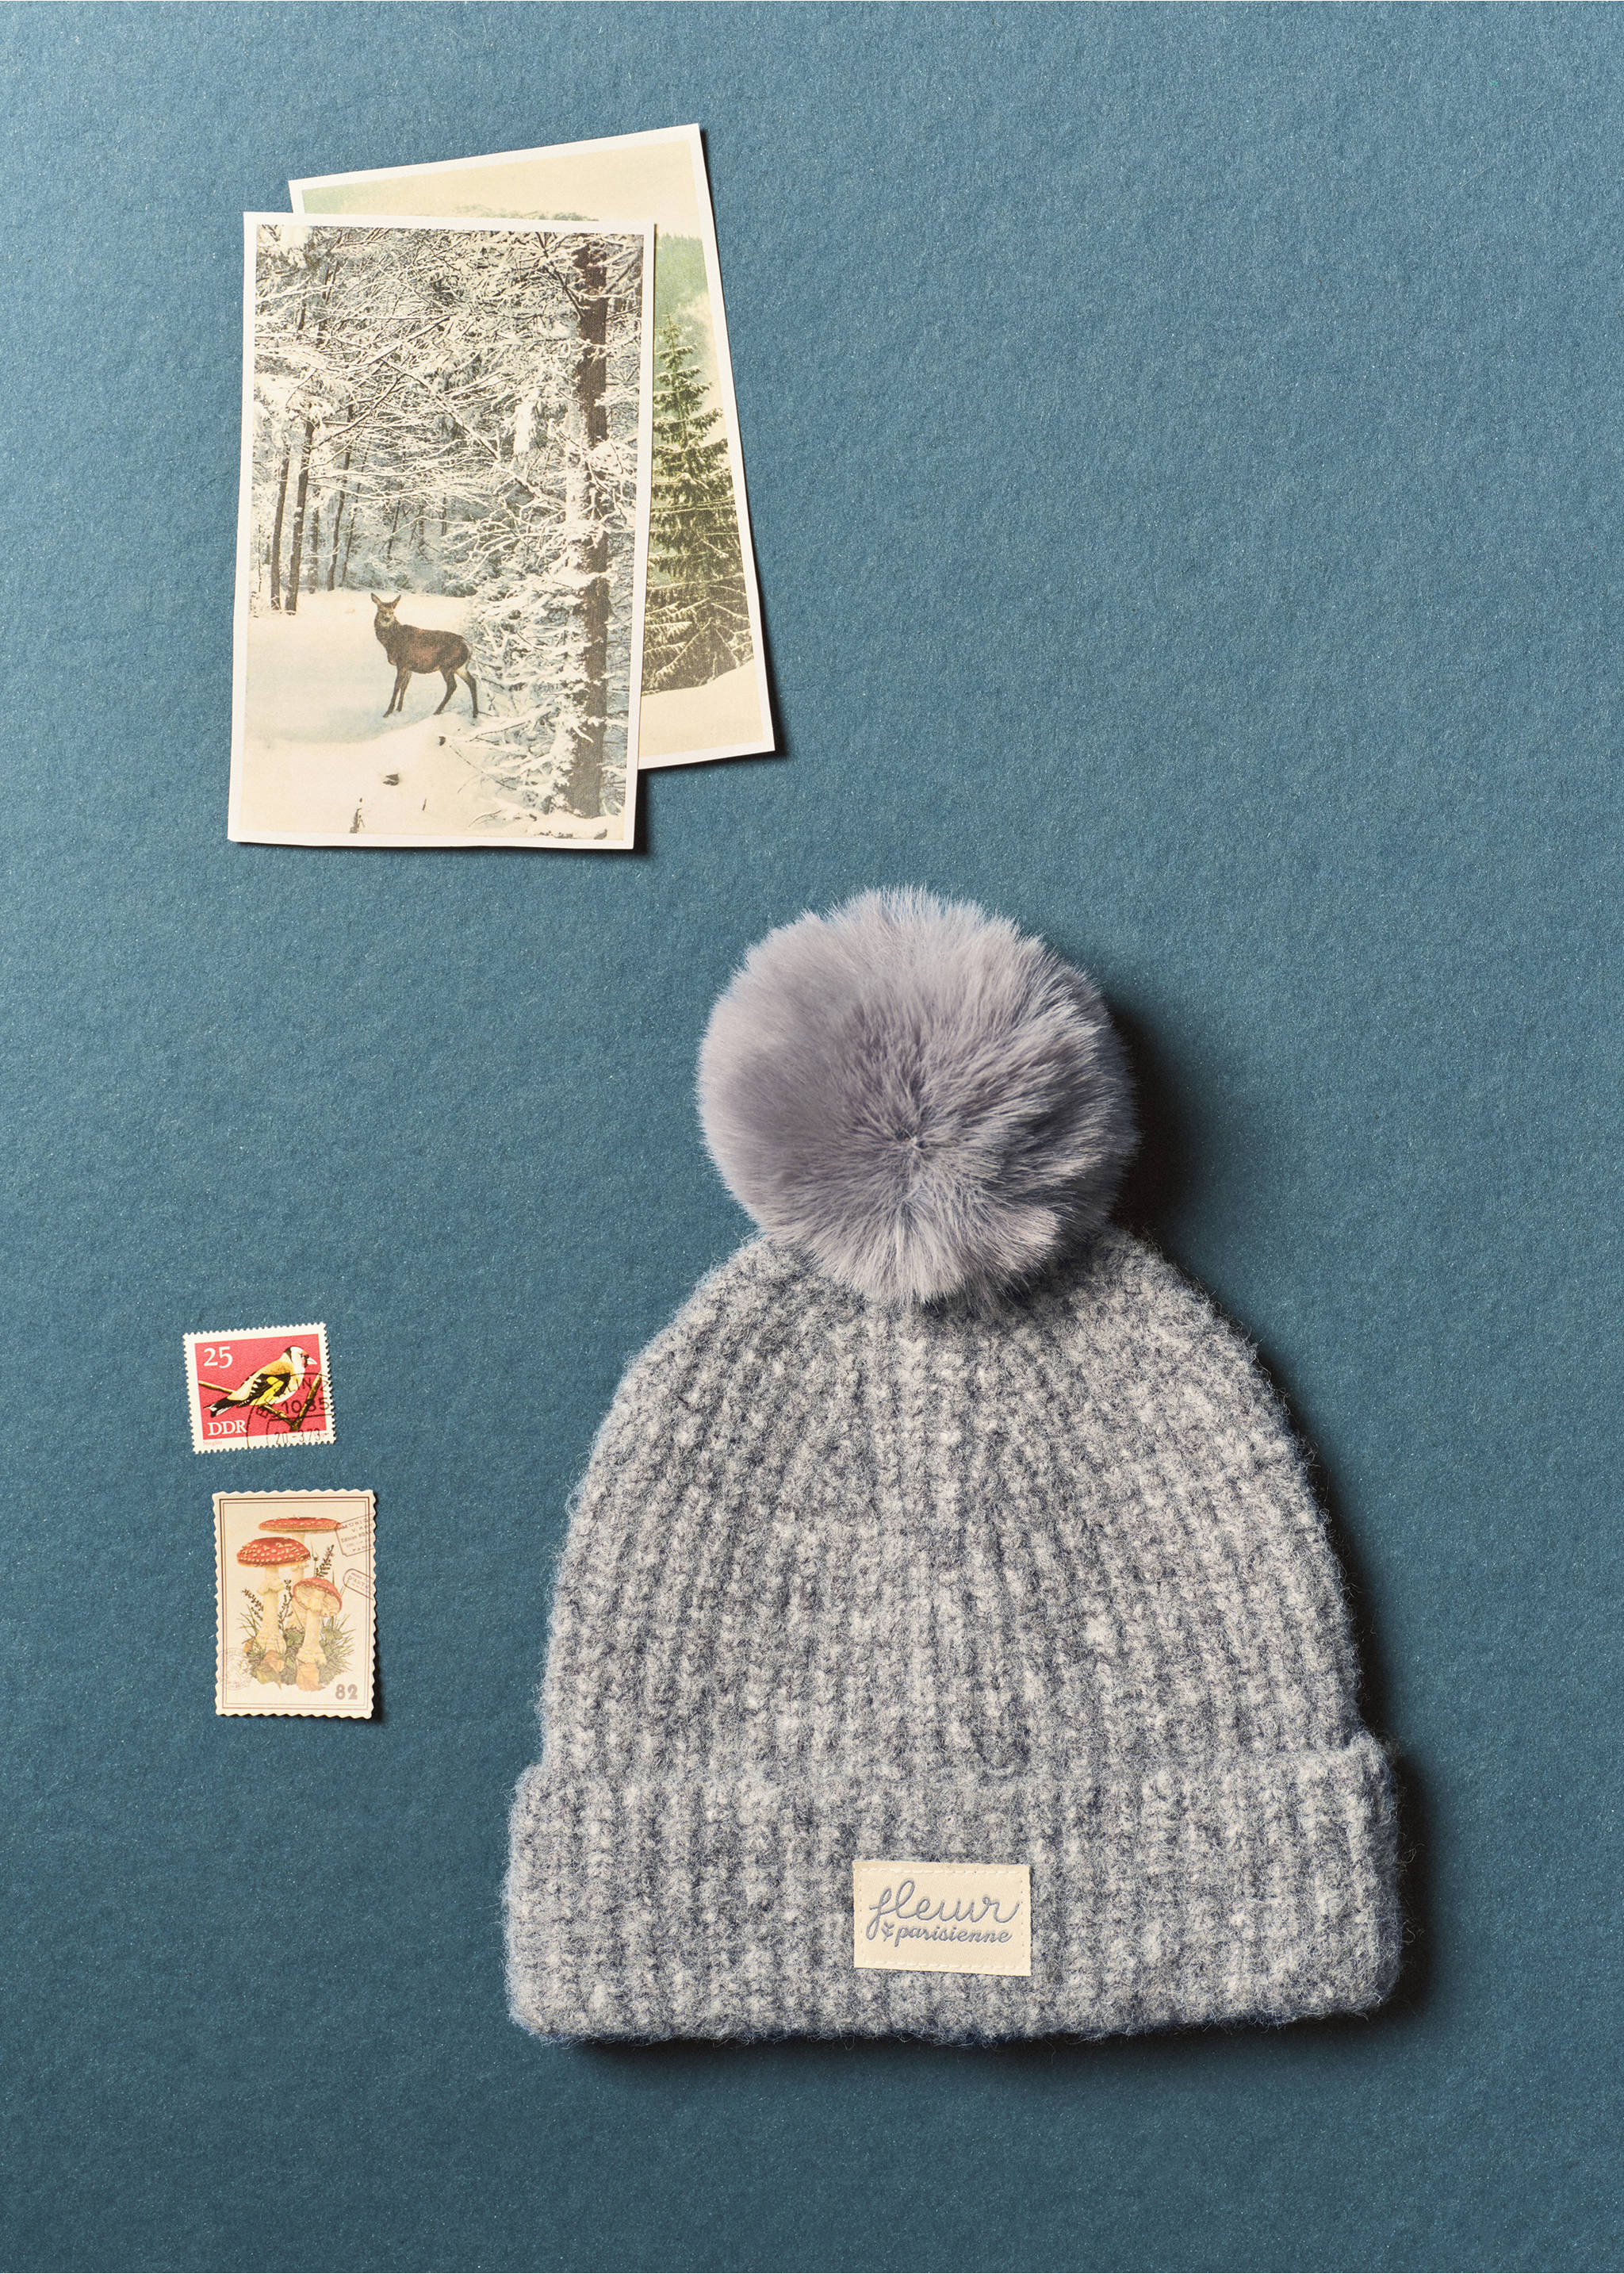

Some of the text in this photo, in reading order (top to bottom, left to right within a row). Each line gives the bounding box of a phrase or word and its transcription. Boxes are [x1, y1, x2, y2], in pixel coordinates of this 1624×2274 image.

[203, 1346, 233, 1369] 25
[207, 1420, 247, 1436] DDR
[335, 1683, 358, 1701] 82
[866, 1877, 1020, 1941] fleur
[894, 1926, 1013, 1947] parisienne
